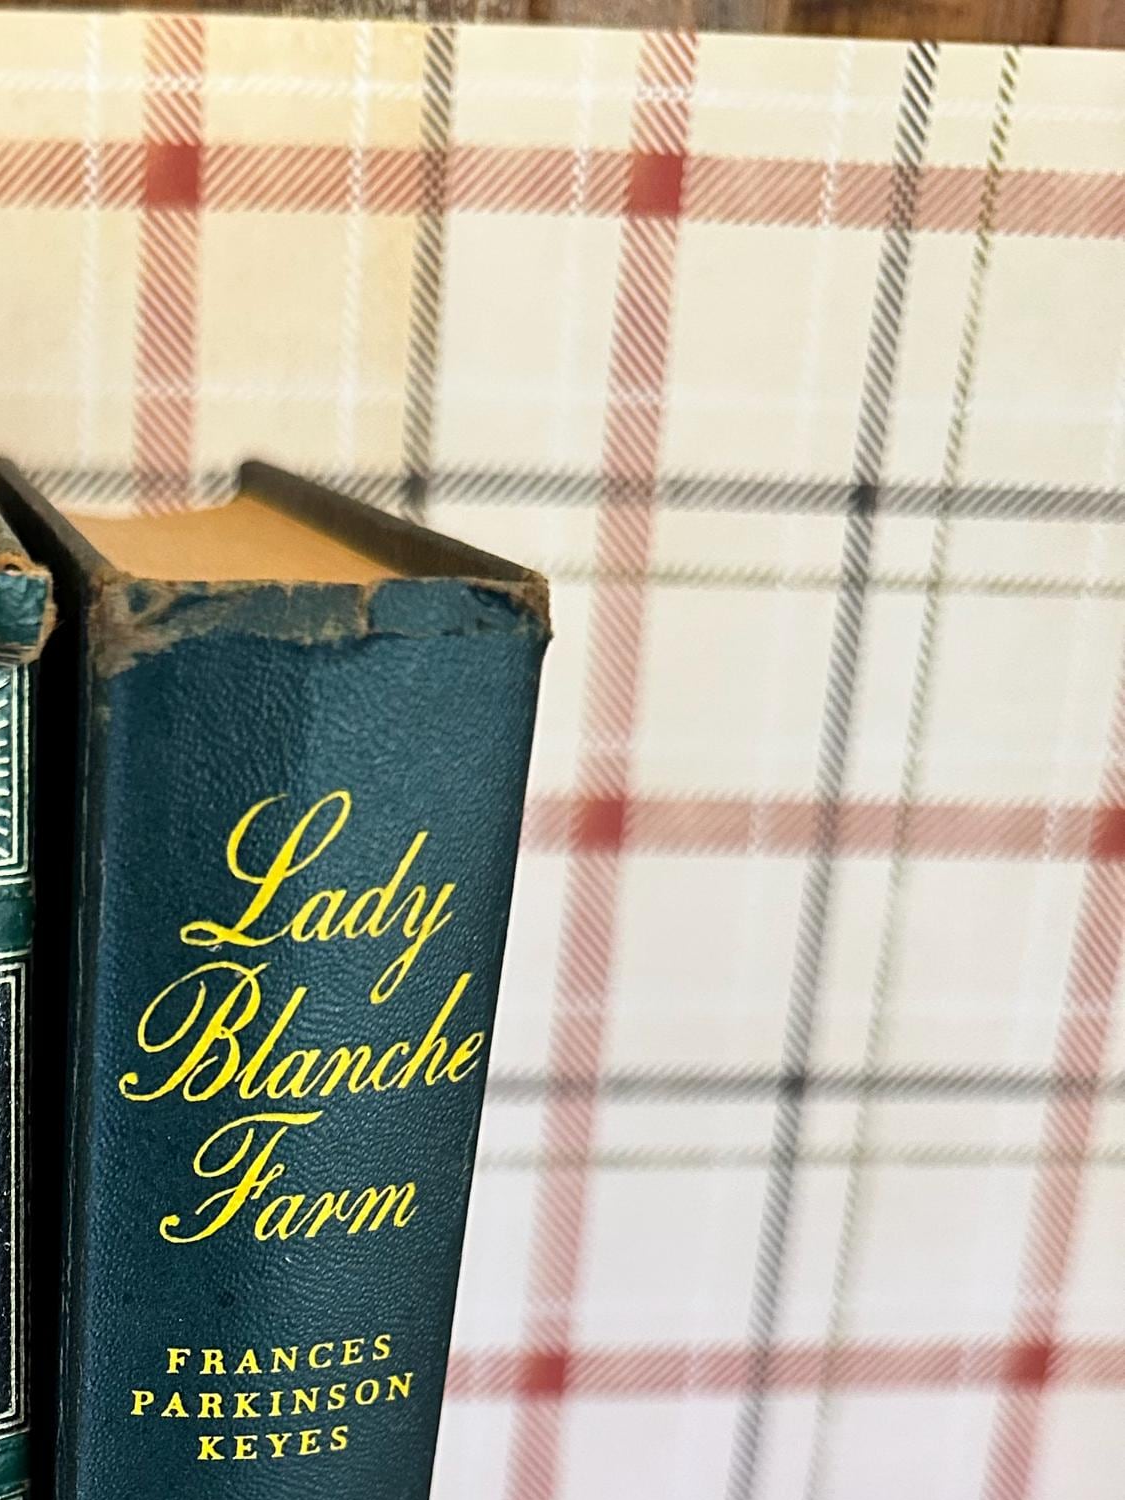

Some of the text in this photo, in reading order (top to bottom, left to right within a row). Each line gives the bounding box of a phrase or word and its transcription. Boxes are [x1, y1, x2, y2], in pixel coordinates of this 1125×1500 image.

[179, 789, 456, 1004] Lady
[118, 960, 486, 1103] Blanche
[159, 1110, 419, 1244] Farm
[130, 1372, 415, 1418] PARKINSON
[166, 1334, 394, 1374] FRANCES
[197, 1425, 349, 1461] KEYES
